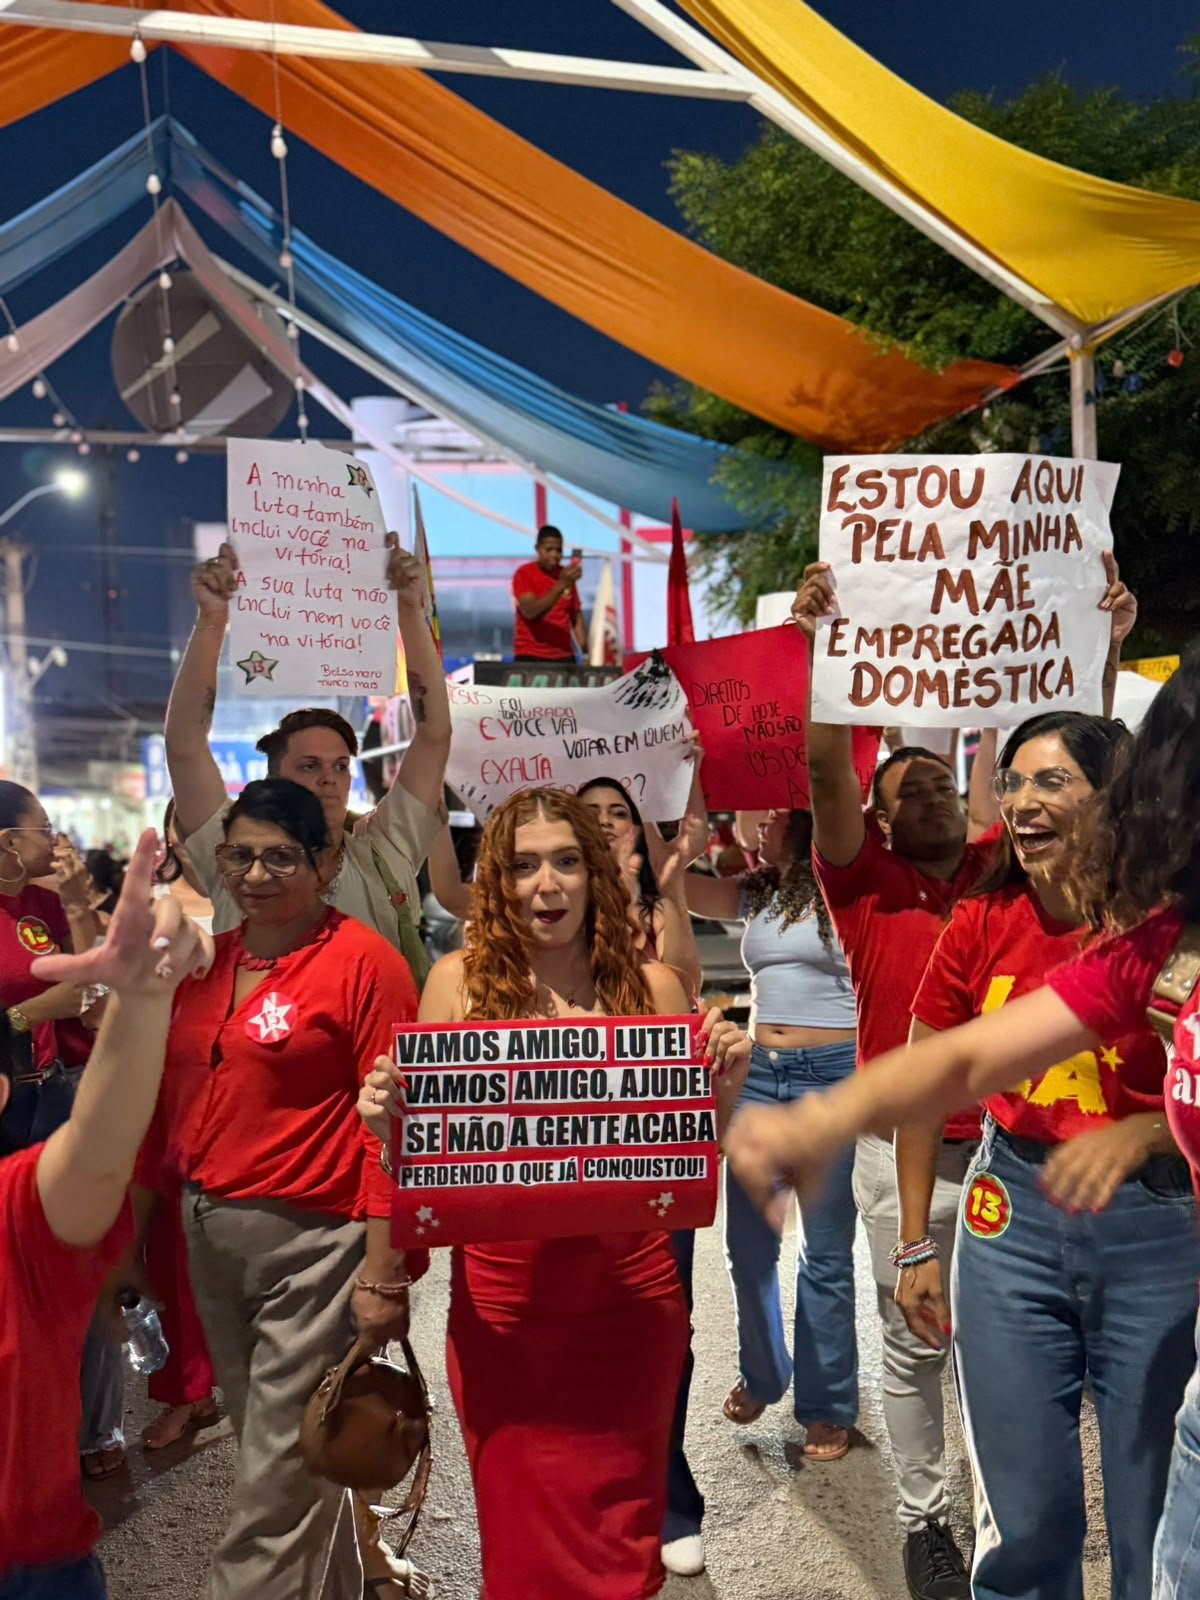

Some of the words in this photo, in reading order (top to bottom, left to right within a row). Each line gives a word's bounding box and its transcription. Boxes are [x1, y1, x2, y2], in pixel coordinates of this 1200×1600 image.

[247, 462, 262, 486] A
[272, 472, 345, 498] minha
[827, 464, 985, 513] ESTOU
[1010, 458, 1084, 505] AQUI
[303, 500, 374, 533] também
[342, 537, 370, 552] na
[841, 513, 946, 564] PELA
[967, 511, 1082, 561] MINHA
[275, 547, 352, 574] vitória!
[235, 571, 247, 587] A
[261, 576, 295, 595] sua
[352, 588, 388, 604] não
[930, 559, 1035, 616] MÃE
[298, 609, 343, 628] nem
[352, 615, 391, 631] você
[260, 632, 289, 647] na
[298, 632, 362, 654] vitória!
[827, 611, 1060, 663] EMPREGADA
[690, 678, 750, 708] DIREITOS
[848, 655, 1074, 709] DOMÉSTICA
[500, 697, 522, 712] FOI
[723, 704, 742, 727] DE
[752, 701, 782, 722] HOJE
[480, 716, 496, 740] E
[551, 717, 578, 736] VAI
[563, 738, 611, 760] VOTAR
[614, 731, 639, 754] EM
[644, 722, 685, 747] QUEM
[744, 719, 775, 744] NÃO
[481, 753, 552, 785] EXALTA
[23, 926, 48, 945] 13
[398, 1030, 500, 1064] VAMOS
[506, 1027, 606, 1061] AMIGO,
[615, 1026, 686, 1059] LUTE!
[404, 1073, 506, 1104] VAMOS
[514, 1068, 614, 1101] AMIGO,
[620, 1066, 711, 1098] AJUDE!
[406, 1122, 440, 1153] SE
[447, 1116, 506, 1152] NÃO
[510, 1117, 528, 1146] A
[536, 1114, 620, 1146] GENTE
[623, 1111, 714, 1144] ACABA
[401, 1163, 497, 1188] PERDENDO
[502, 1163, 514, 1183] O
[519, 1161, 554, 1185] QUE
[558, 1157, 578, 1182] JÁ
[584, 1157, 704, 1179] CONQUISTOU!
[972, 1187, 1002, 1222] 13
